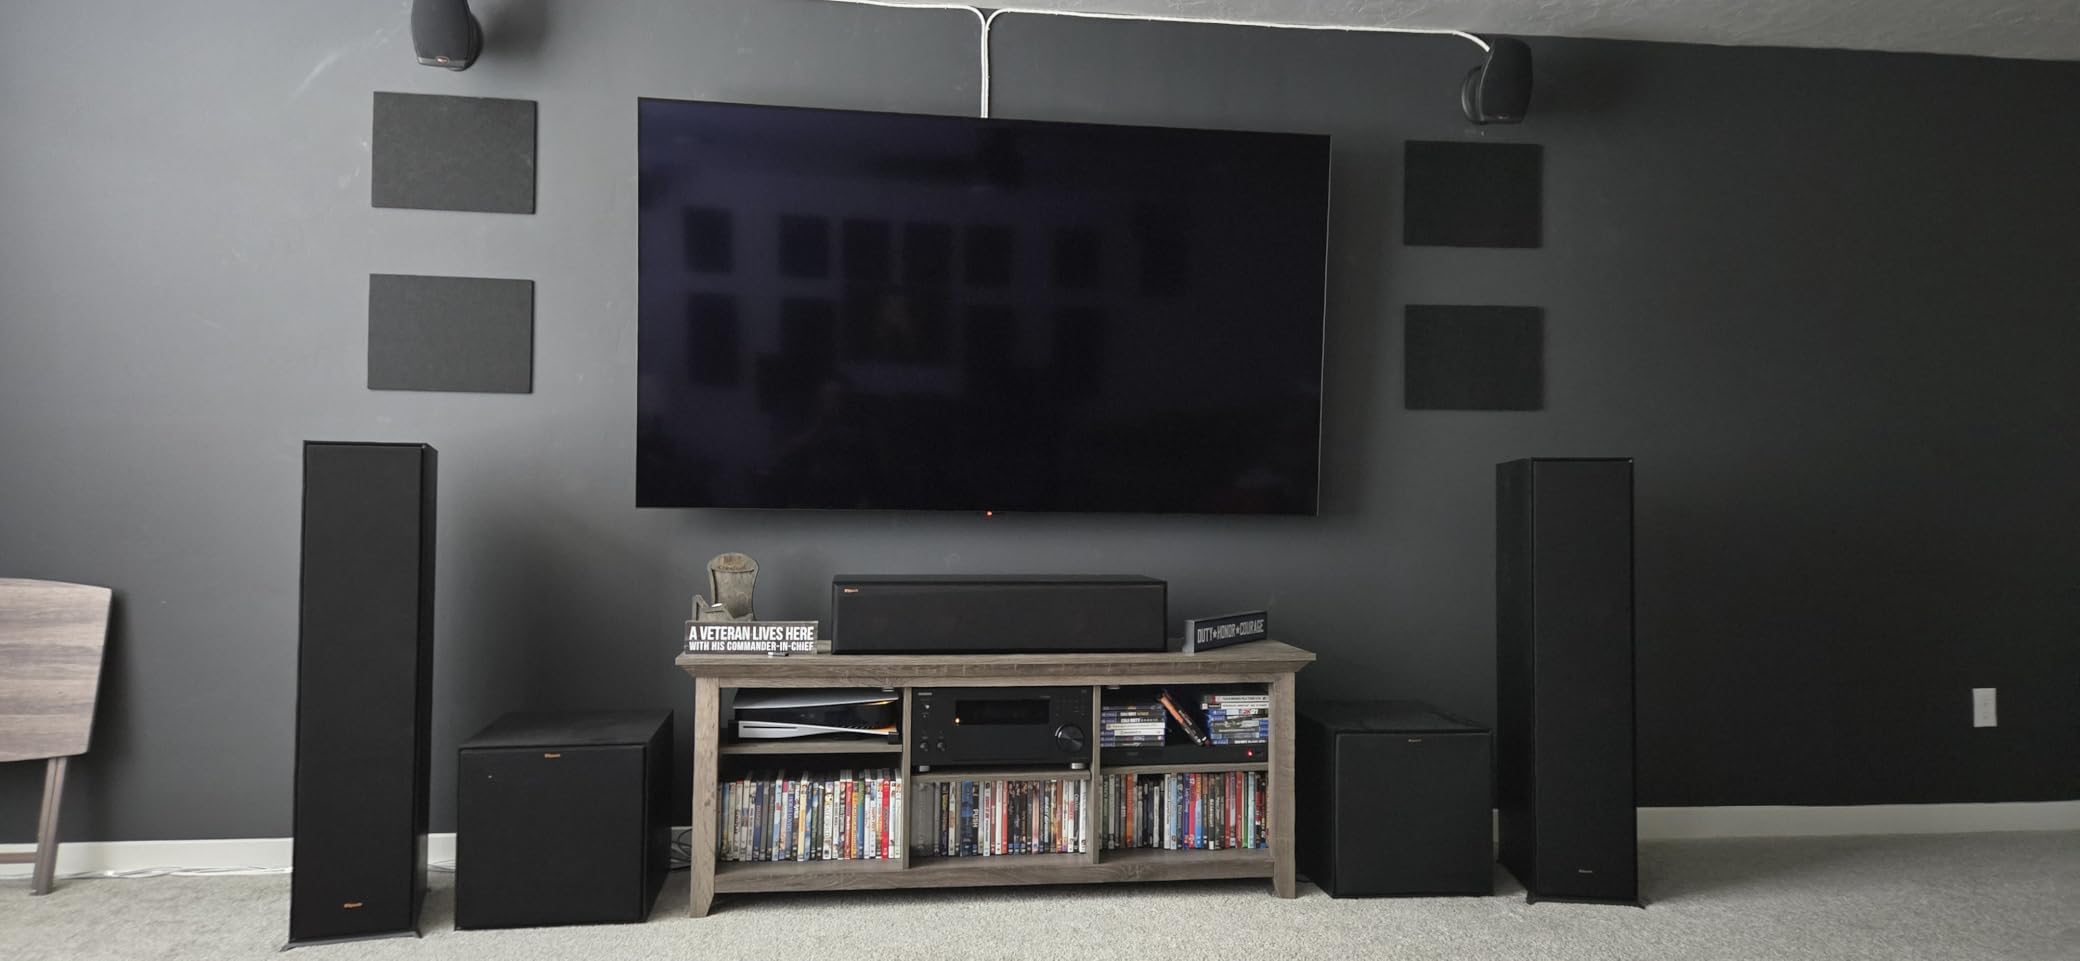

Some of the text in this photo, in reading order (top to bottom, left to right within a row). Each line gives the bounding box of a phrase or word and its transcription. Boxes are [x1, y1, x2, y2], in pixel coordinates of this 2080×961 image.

[689, 626, 814, 640] A VETERAN LIVES HERE
[1197, 619, 1264, 643] DUTY HONOR COURAGE
[689, 641, 814, 651] WITH HIS COMMANDER-IN-CHIEF
